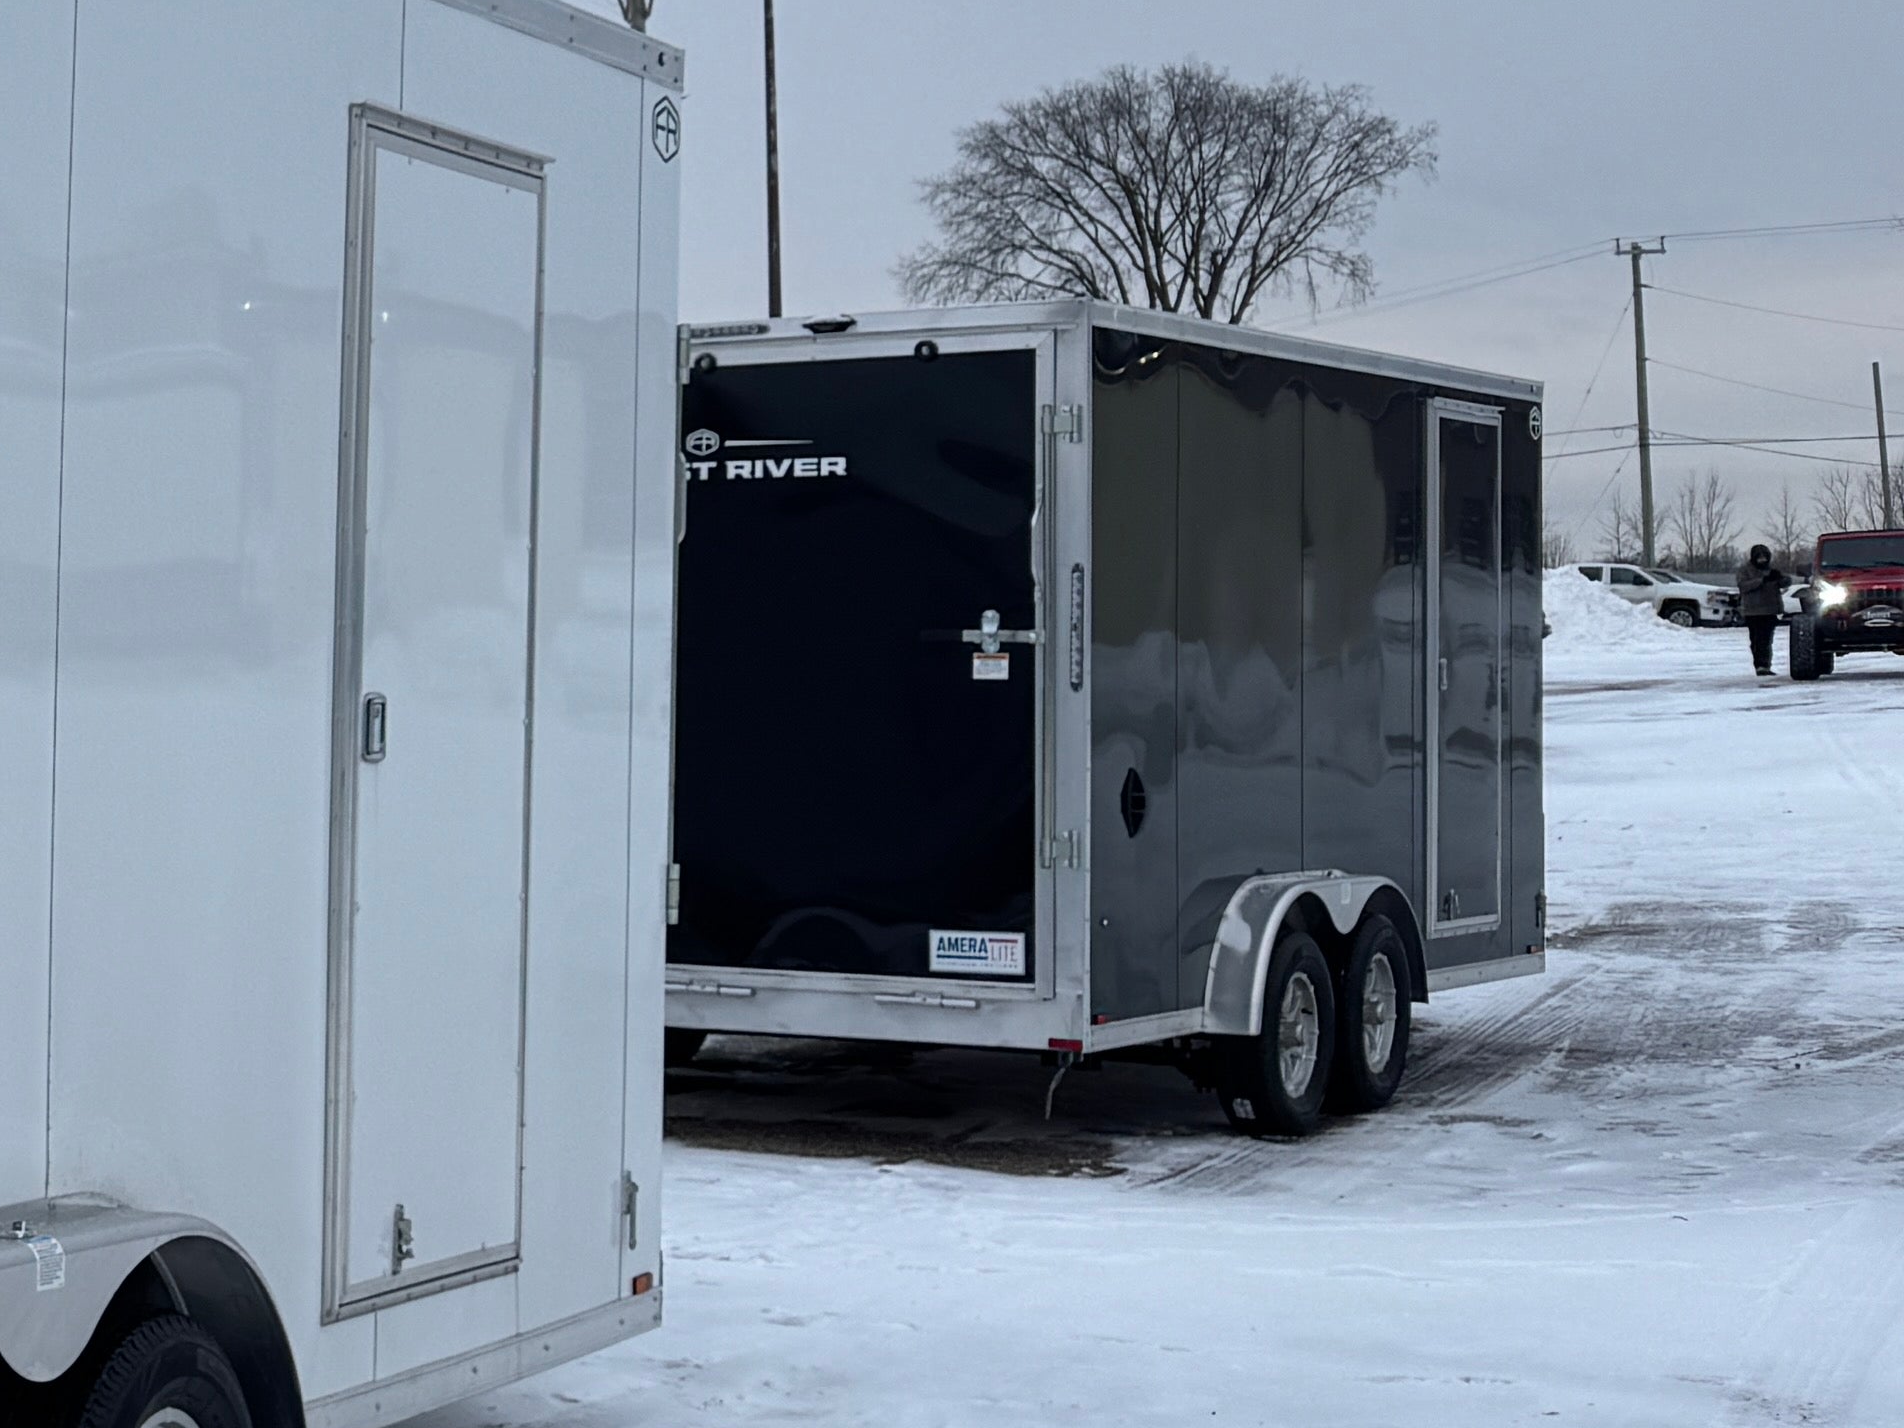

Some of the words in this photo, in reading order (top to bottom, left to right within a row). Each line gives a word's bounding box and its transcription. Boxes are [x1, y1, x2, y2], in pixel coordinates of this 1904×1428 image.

[724, 456, 848, 480] RIVER
[936, 936, 989, 954] AMERA
[991, 944, 1018, 963] LITE
